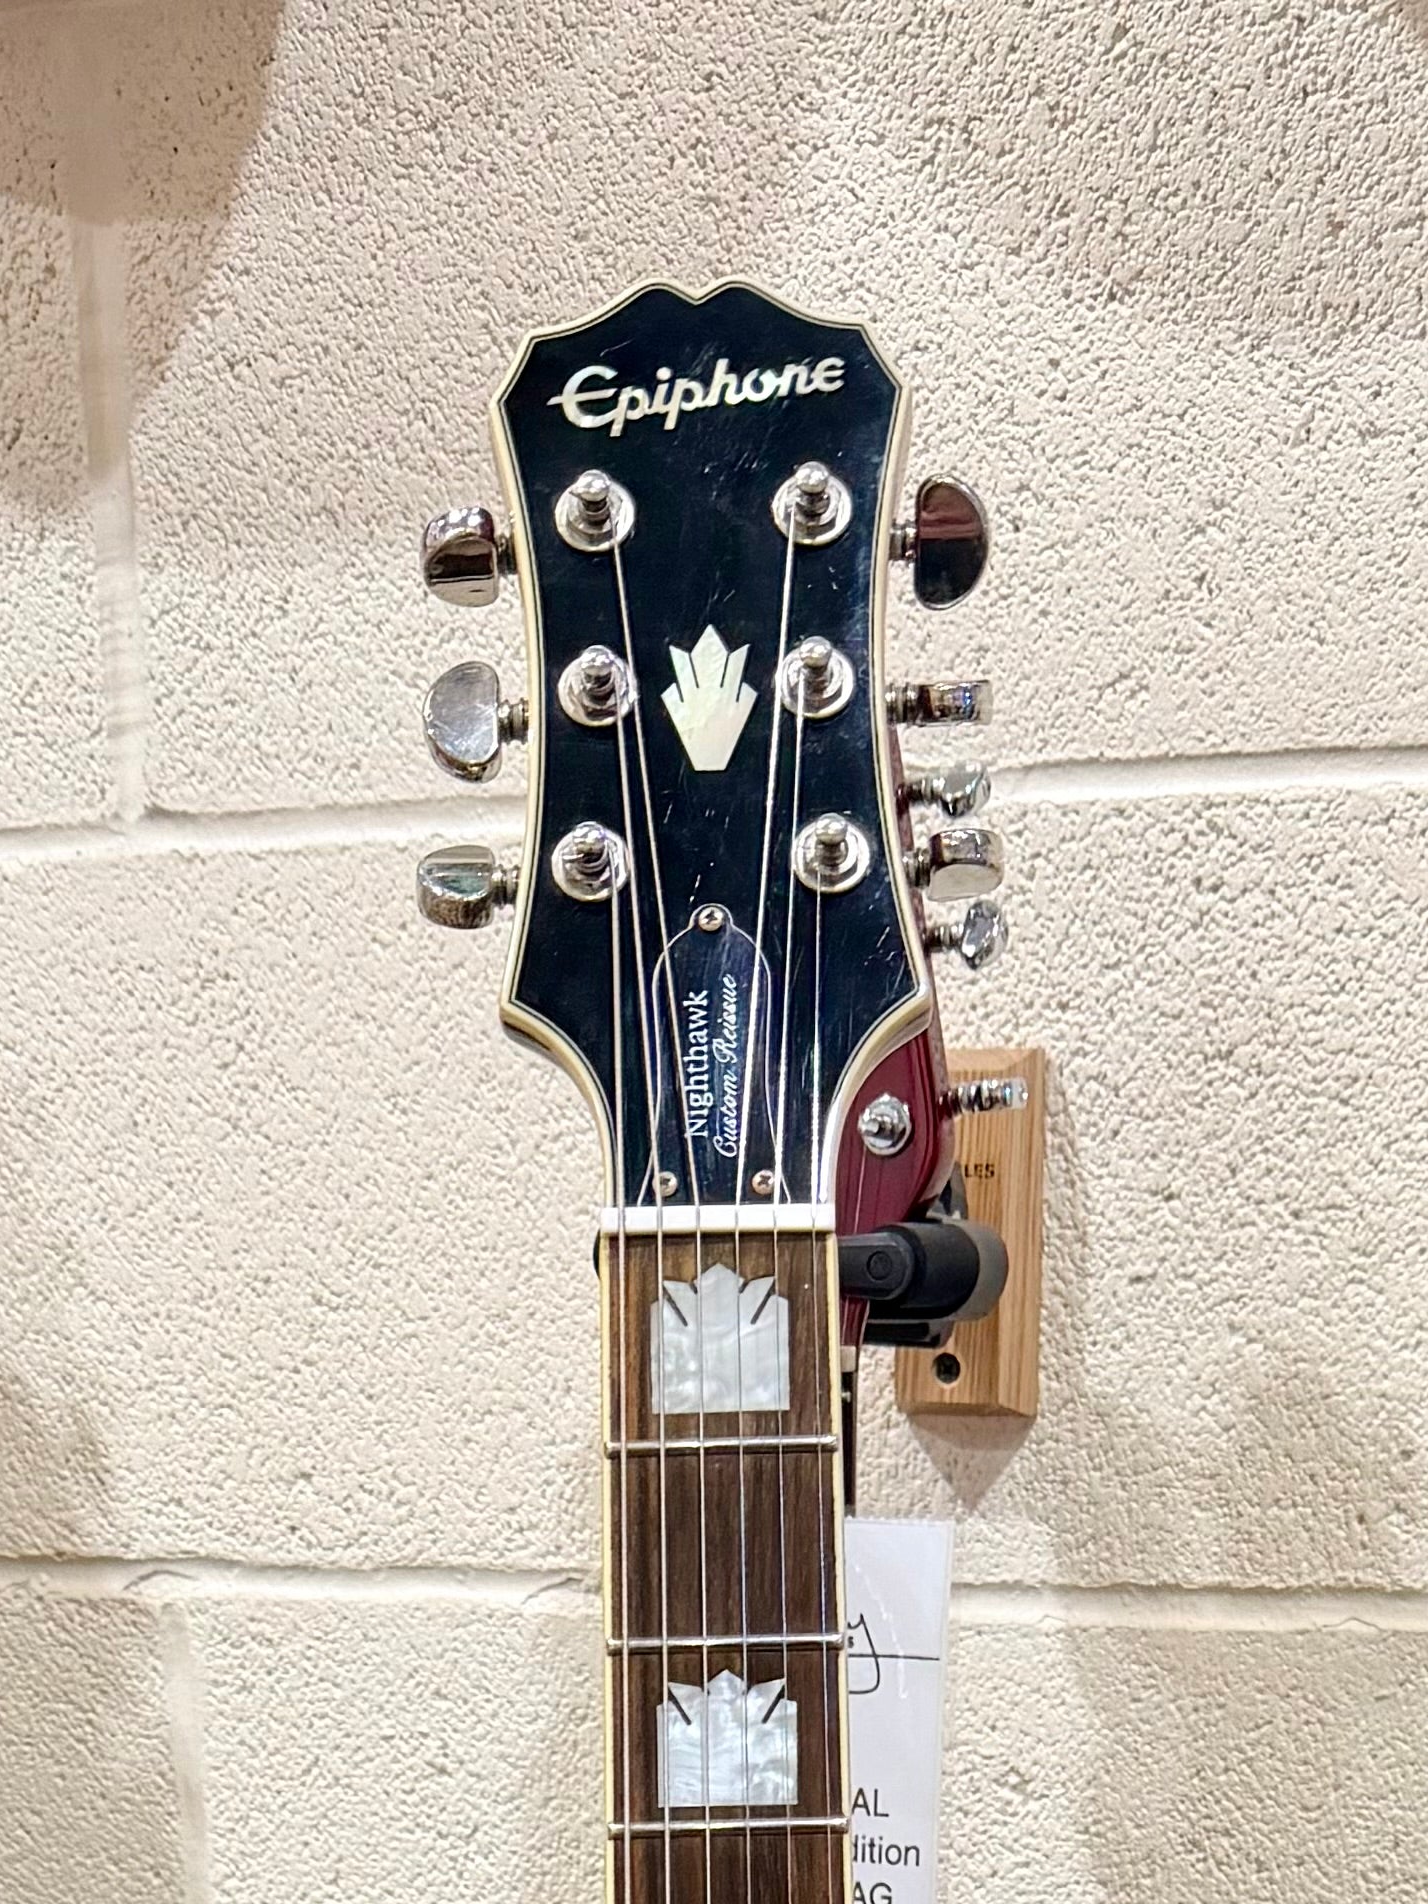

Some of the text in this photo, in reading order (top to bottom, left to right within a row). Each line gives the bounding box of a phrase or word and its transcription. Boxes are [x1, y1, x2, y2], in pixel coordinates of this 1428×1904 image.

[546, 357, 845, 437] Epiphone
[683, 990, 713, 1139] Nighthawk
[712, 974, 737, 1157] Custom Reissue
